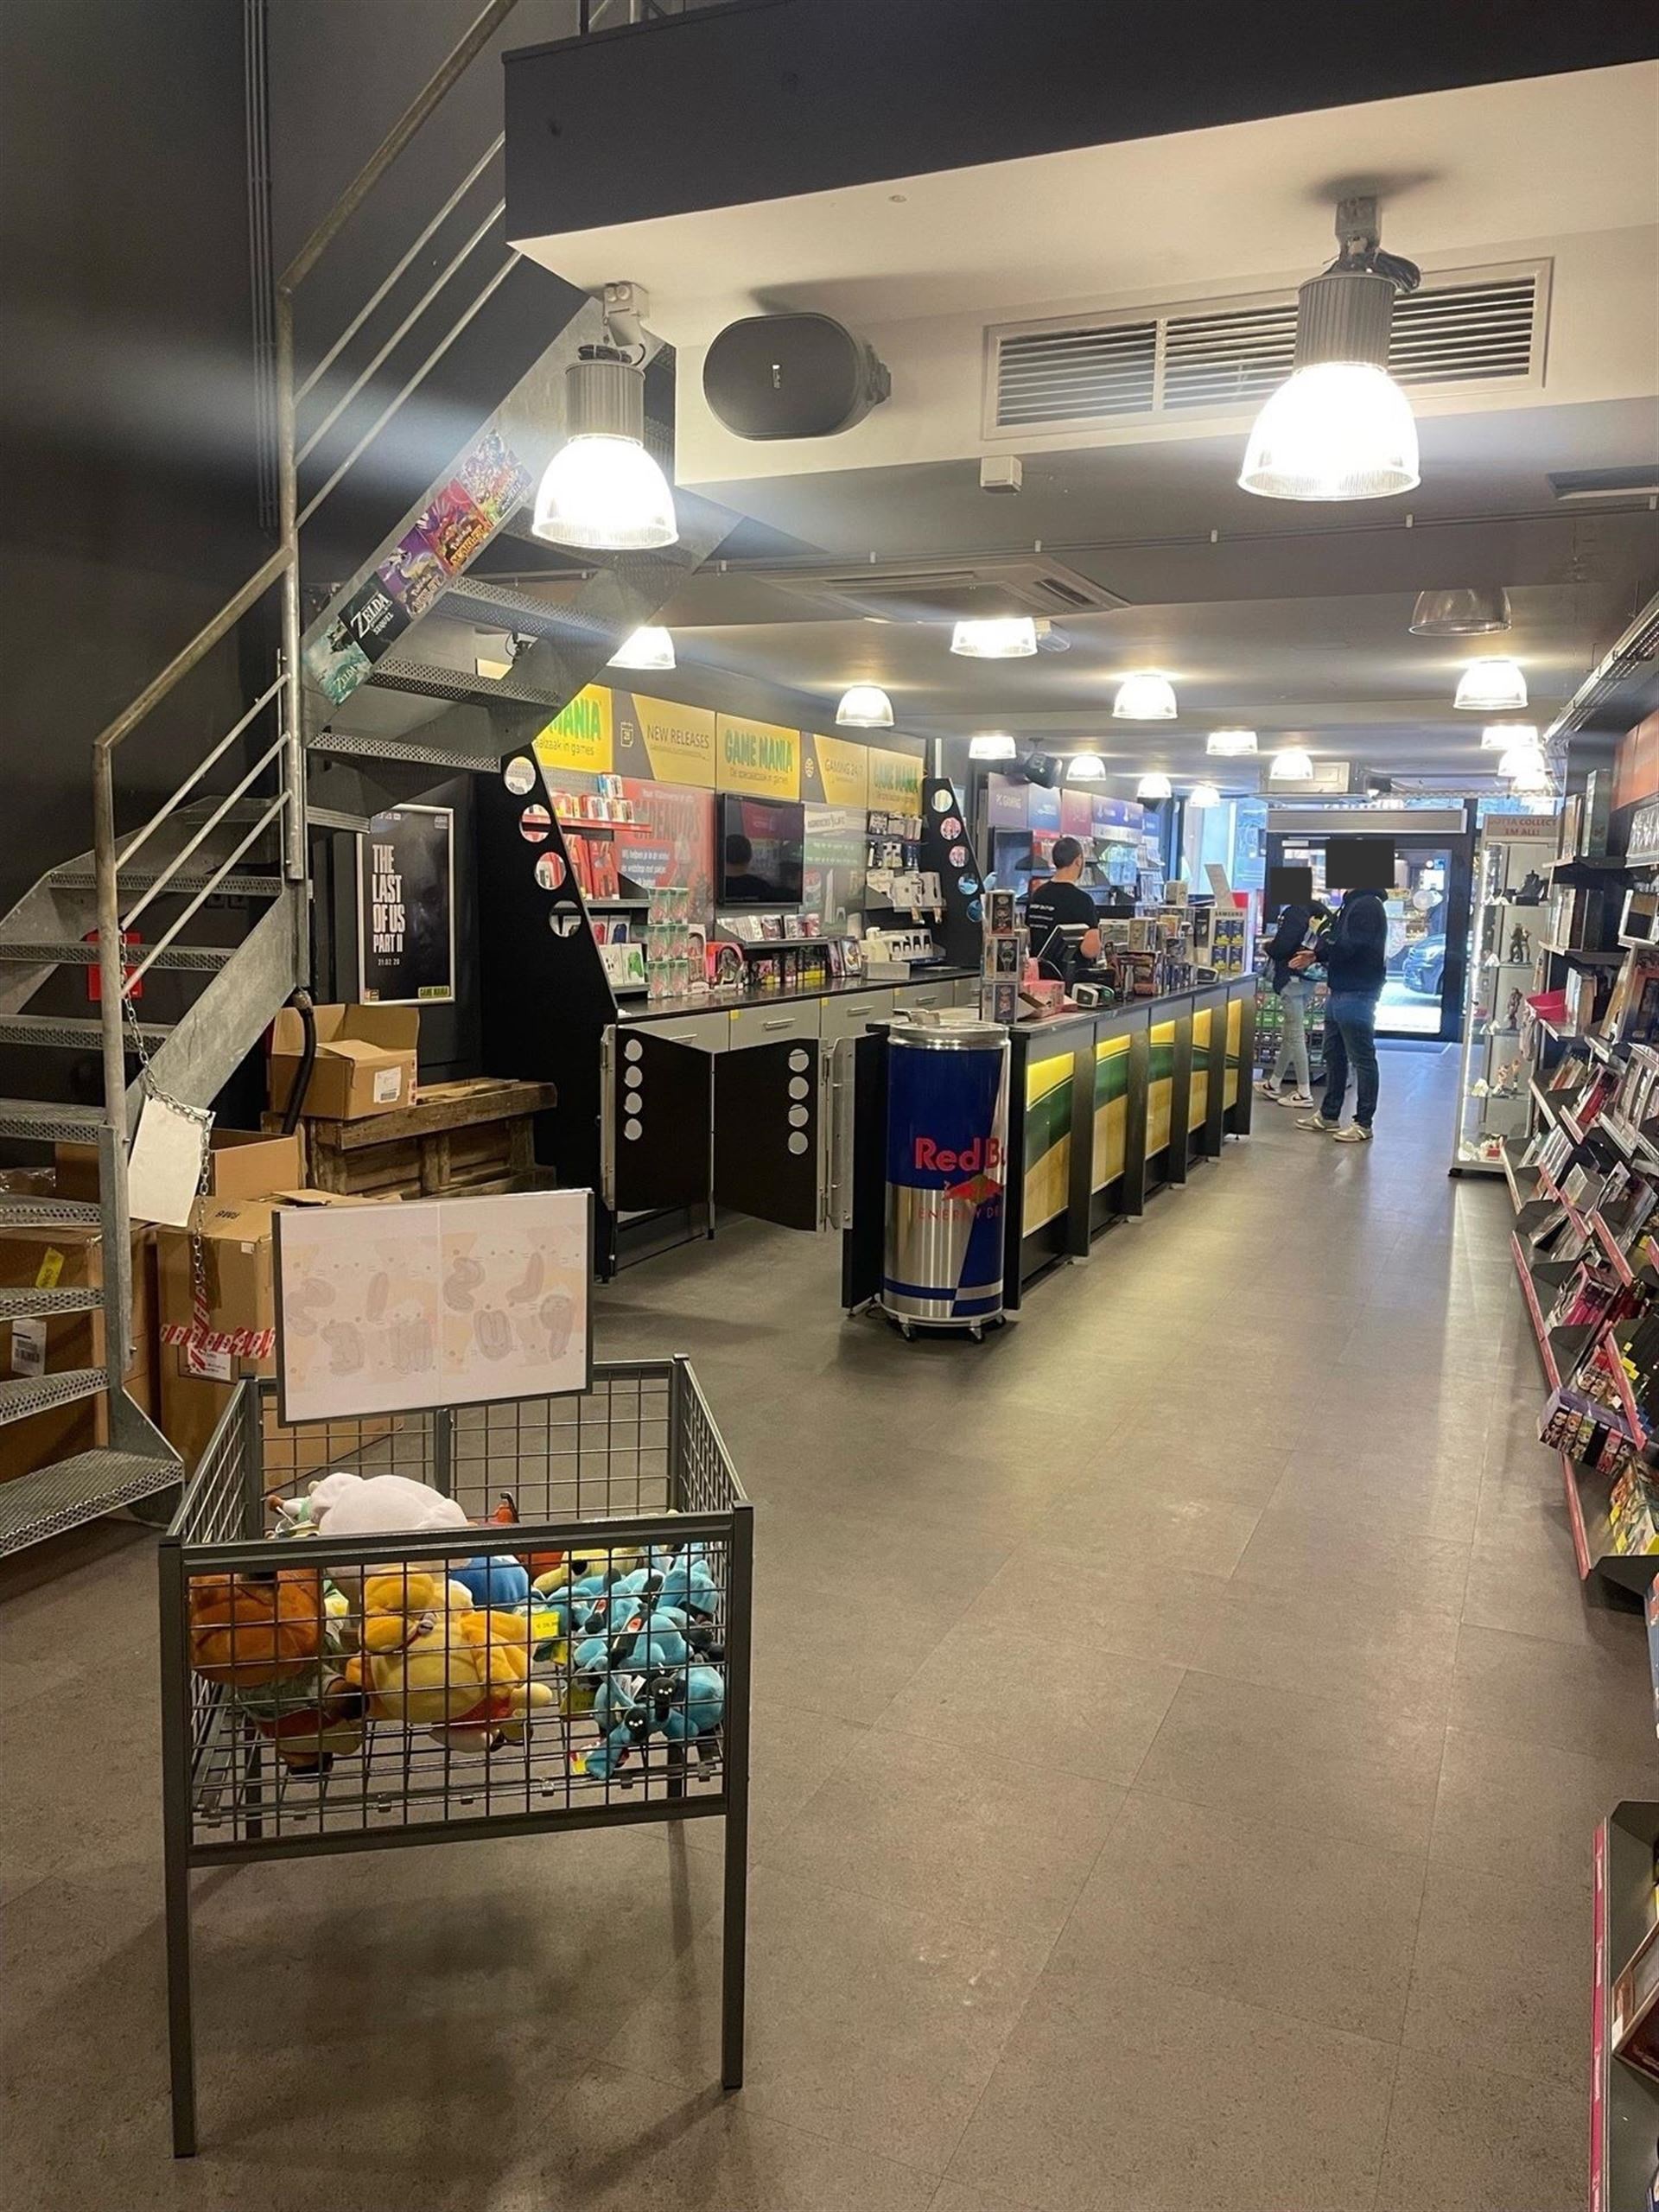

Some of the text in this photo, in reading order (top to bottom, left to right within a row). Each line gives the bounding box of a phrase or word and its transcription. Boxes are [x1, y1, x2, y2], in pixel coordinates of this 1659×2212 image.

[350, 593, 391, 639] ZELDA
[373, 613, 394, 636] SEQUEL
[571, 743, 594, 756] games
[647, 725, 710, 749] NEW RELEASES
[725, 728, 757, 767] GAME
[760, 735, 793, 773] MANIA
[1519, 818, 1556, 827] COLLECT
[372, 844, 395, 874] THE
[372, 874, 403, 904] LAST
[372, 904, 405, 933] OF US
[373, 933, 404, 953] PART II
[915, 1137, 981, 1172] Red
